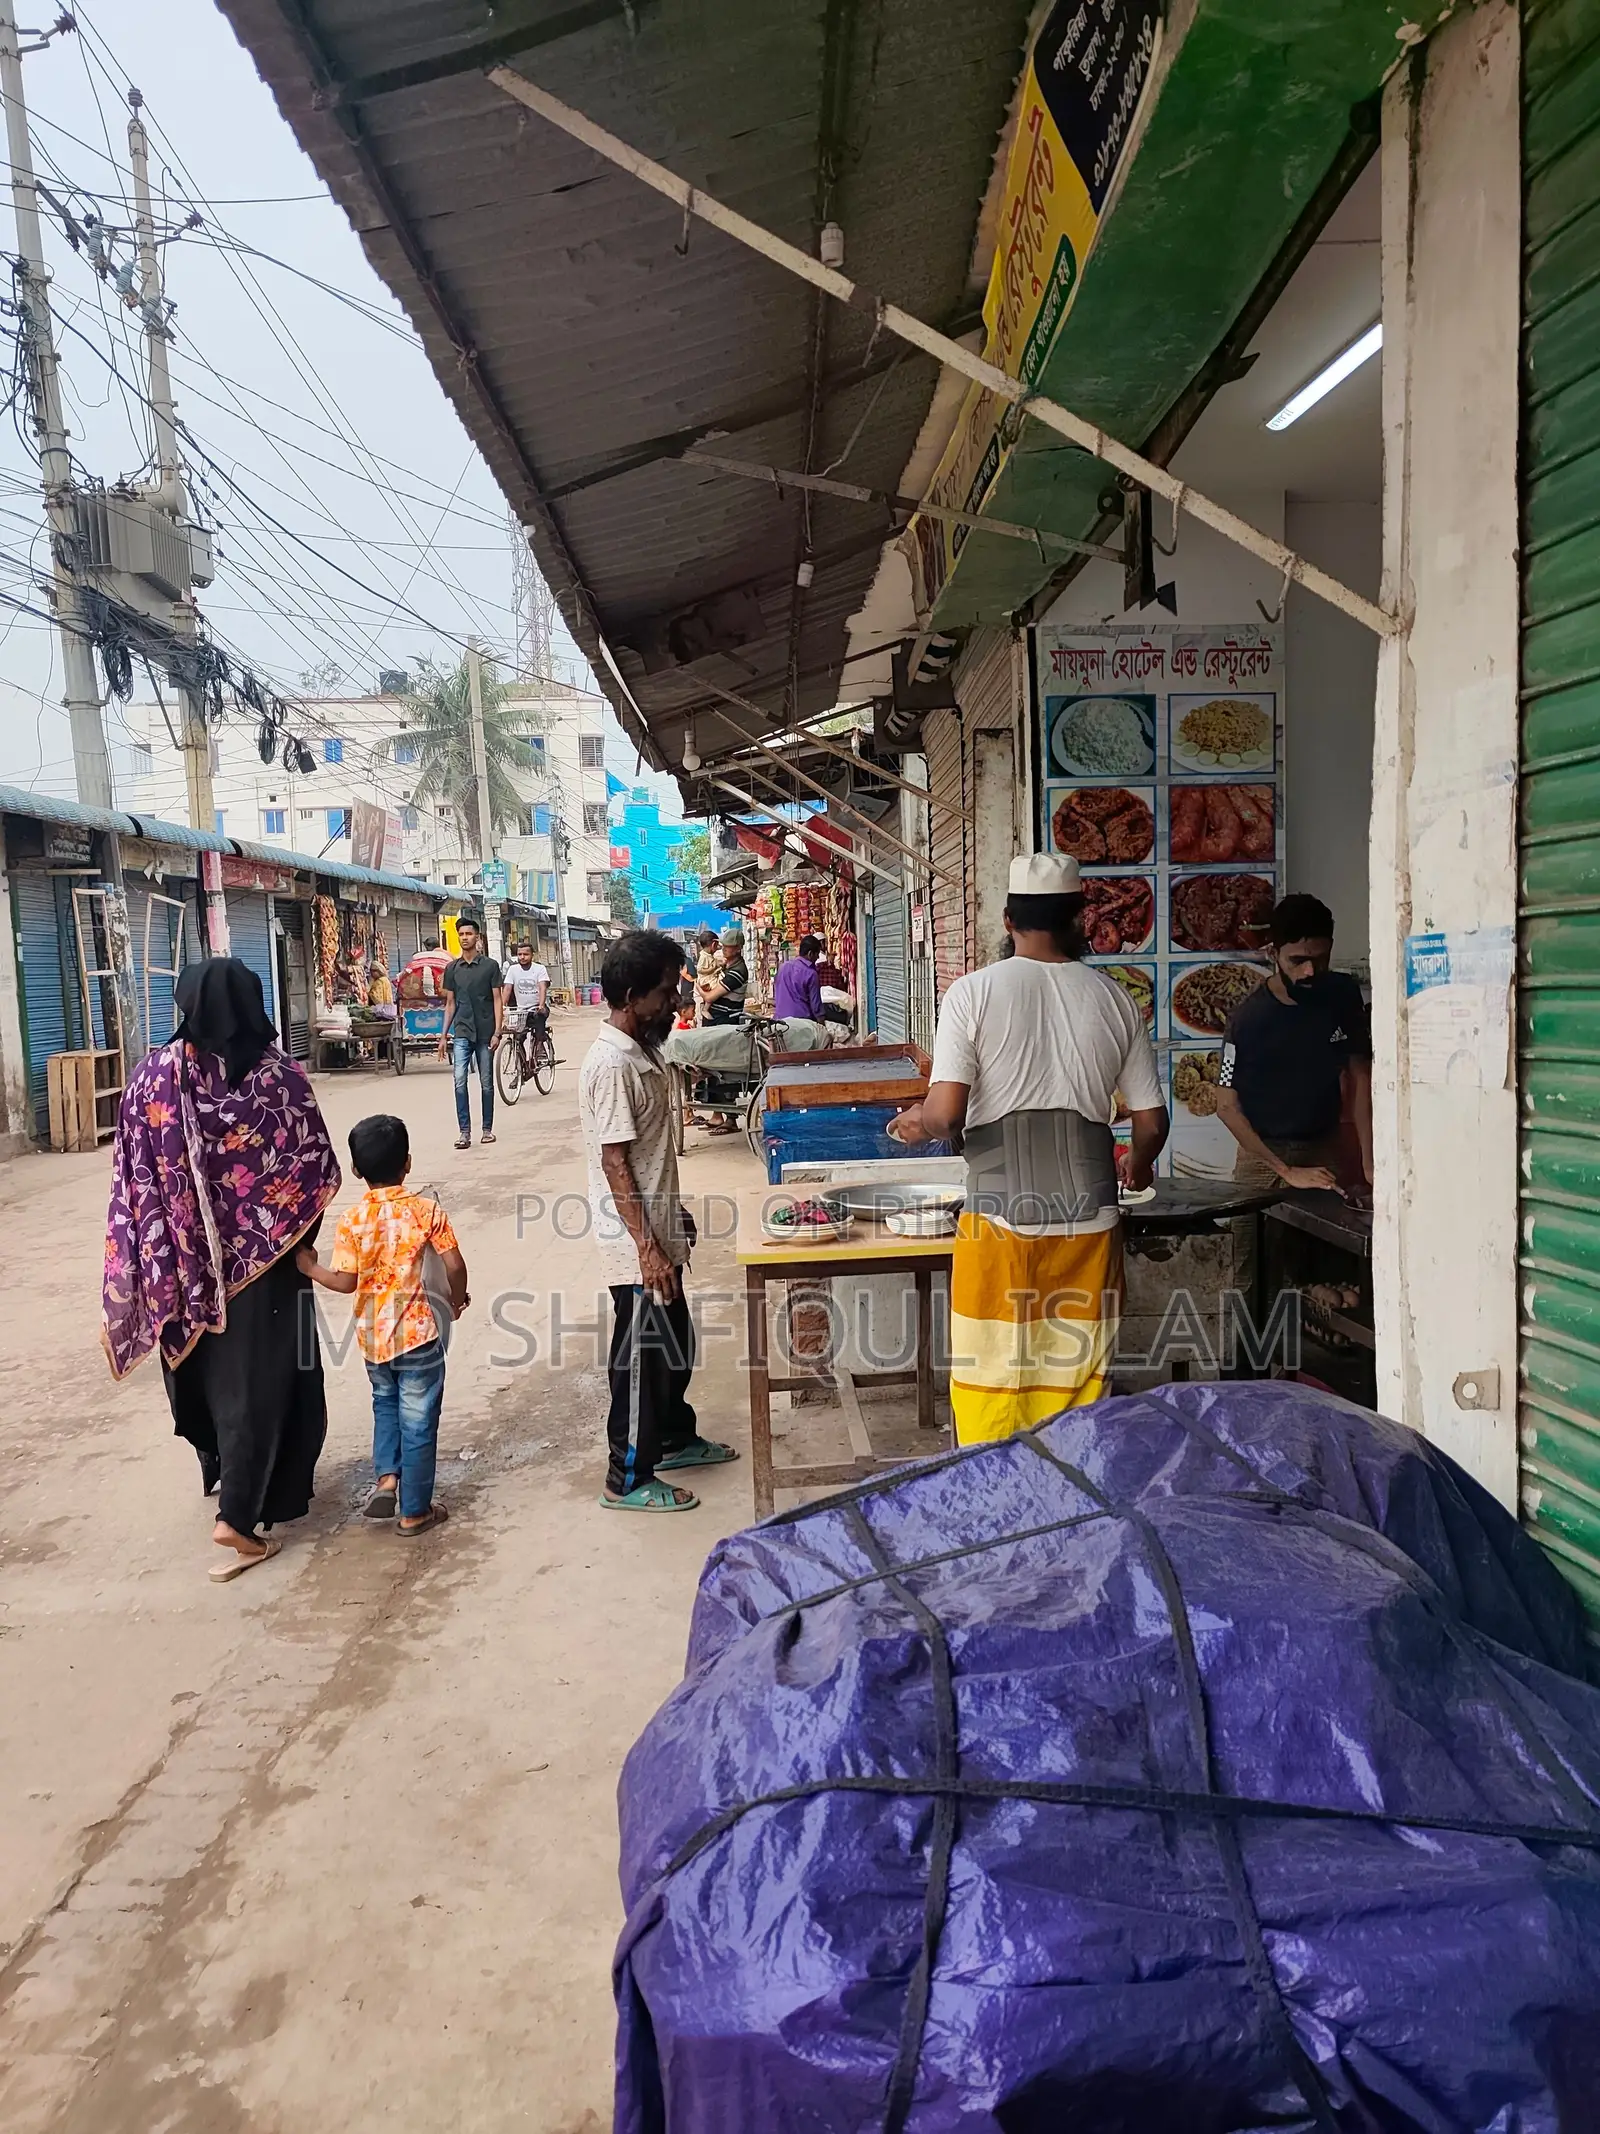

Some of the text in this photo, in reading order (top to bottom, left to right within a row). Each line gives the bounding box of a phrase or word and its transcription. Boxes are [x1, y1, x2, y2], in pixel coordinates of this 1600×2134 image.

[1049, 637, 1273, 689] মায়মুনা হোটেল এন্ড রেস্টুরেন্ট
